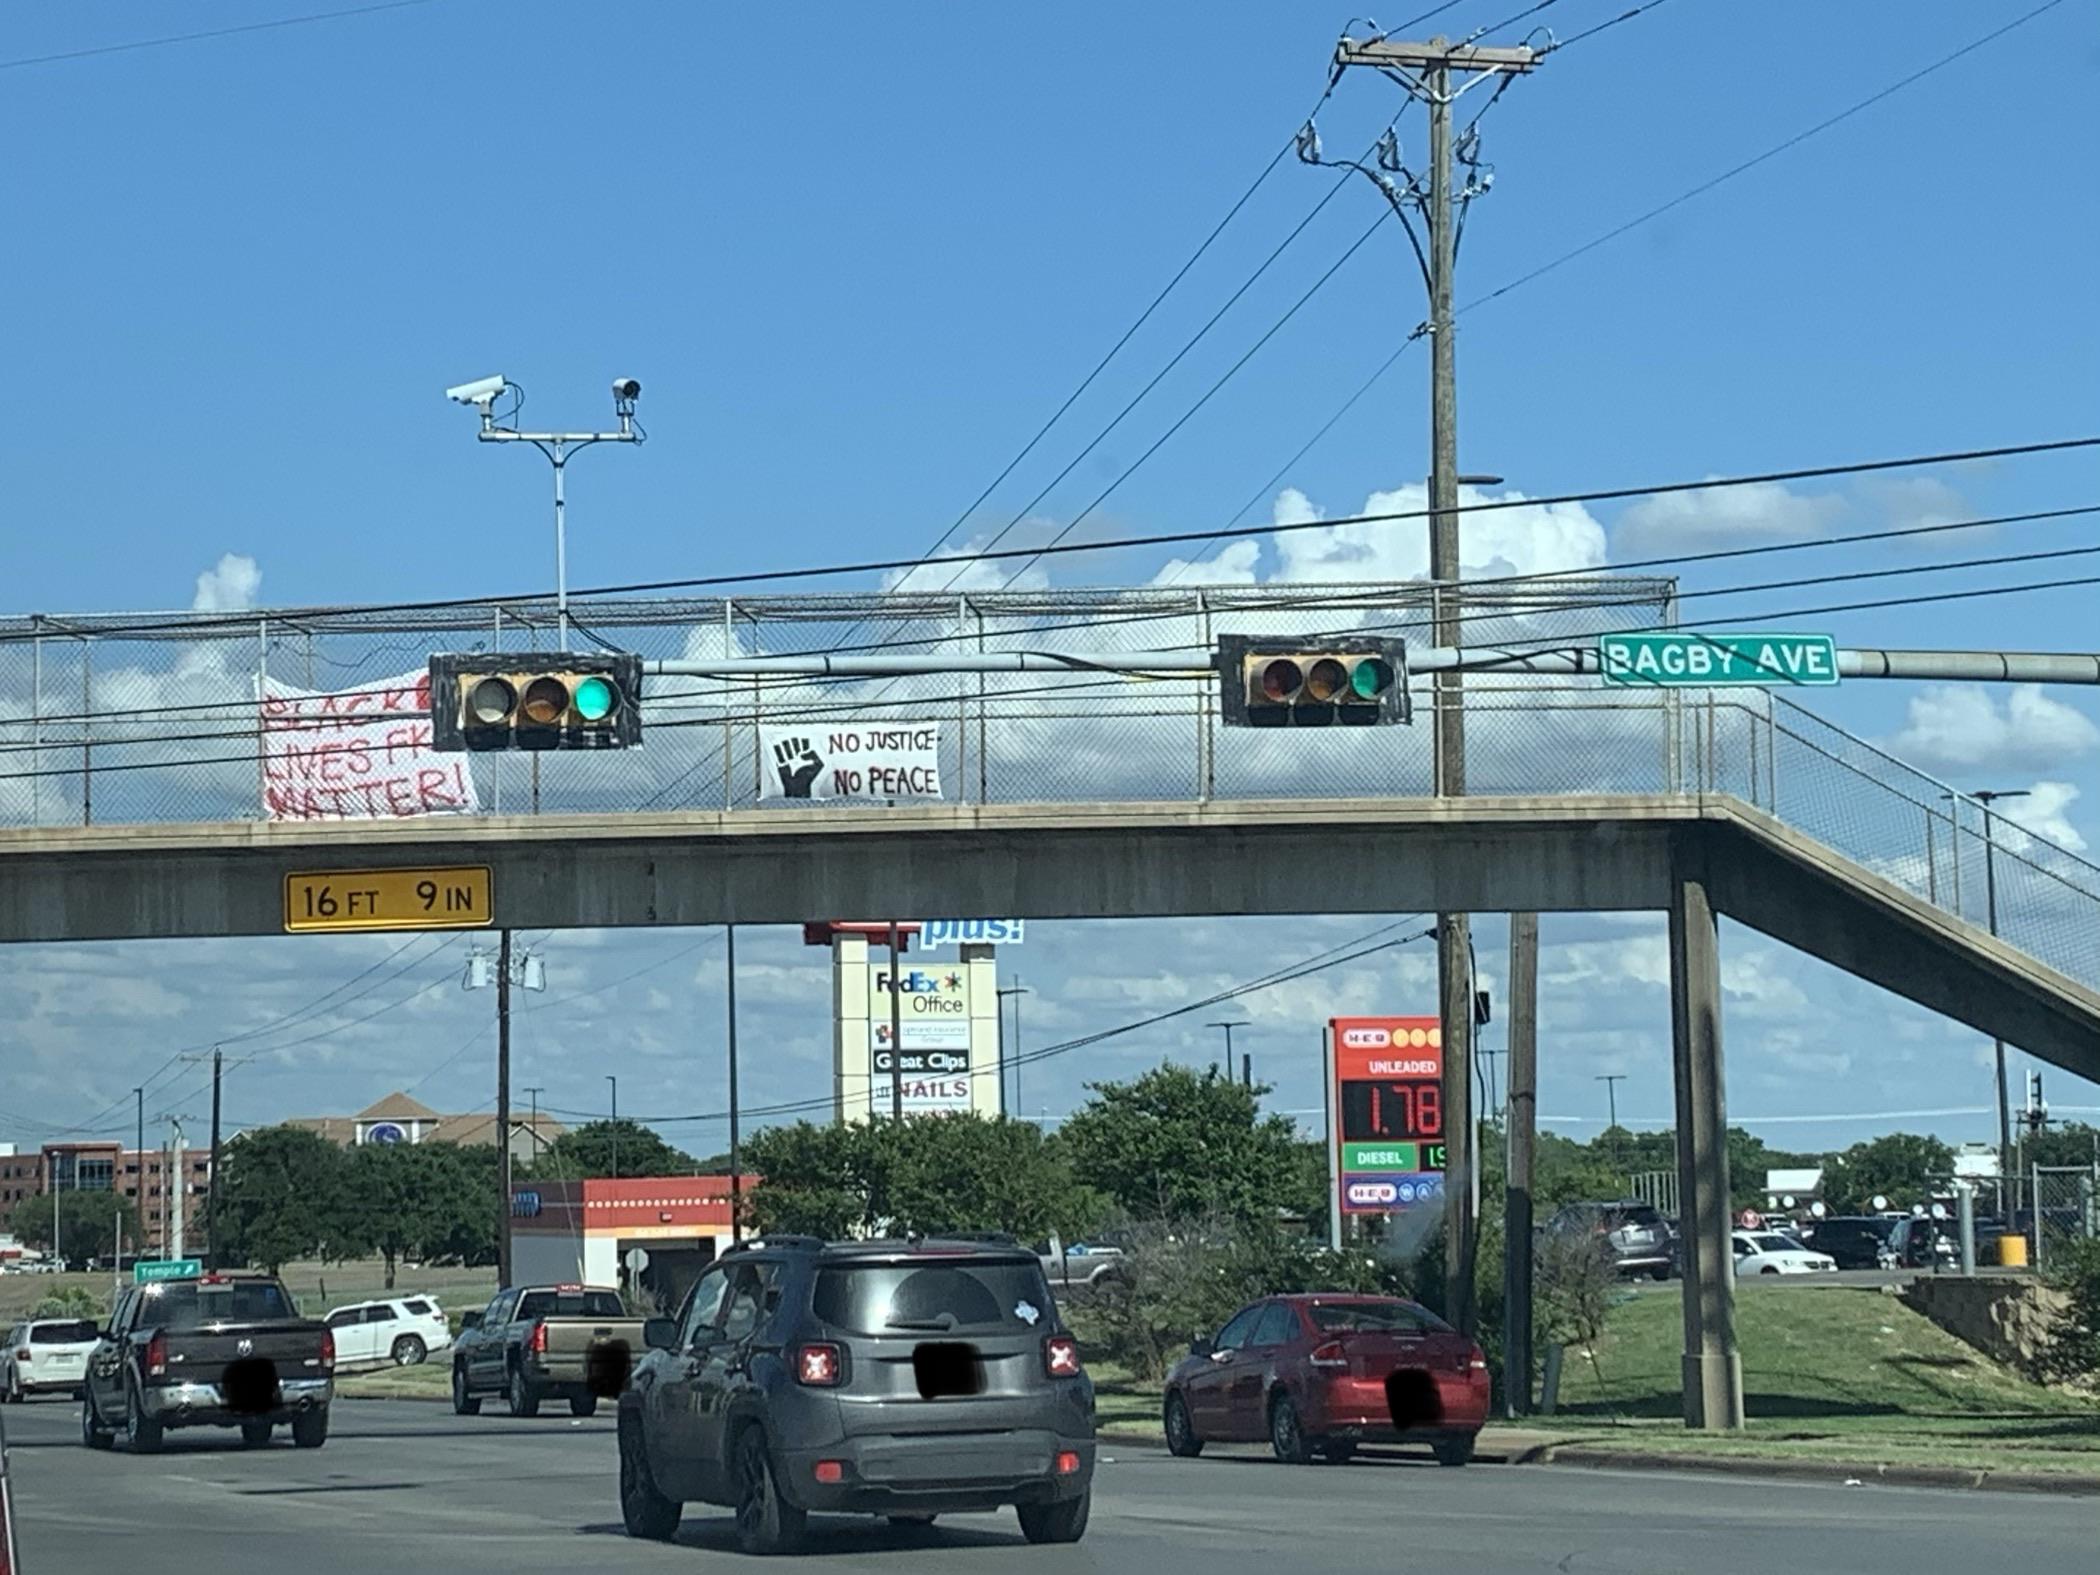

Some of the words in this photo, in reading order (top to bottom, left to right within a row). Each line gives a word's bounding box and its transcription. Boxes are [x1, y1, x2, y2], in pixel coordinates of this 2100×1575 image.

[1608, 644, 1738, 675] BAGBY
[1756, 644, 1830, 675] AVE
[828, 733, 860, 754] NO
[865, 729, 936, 752] JUSTICE
[834, 769, 862, 795] NO
[868, 766, 939, 795] PEACE
[304, 886, 338, 918] 16
[347, 890, 379, 916] FT
[416, 880, 438, 911] 9
[446, 886, 473, 911] IN
[876, 971, 940, 993] FdEx
[913, 995, 963, 1013] Office
[876, 1052, 924, 1069] Geat
[927, 1052, 967, 1071] Clips
[1368, 1060, 1438, 1074] UNLEADED
[900, 1081, 968, 1098] NAILS
[1371, 1085, 1441, 1135] 1.78
[1357, 1151, 1403, 1165] DIESEL
